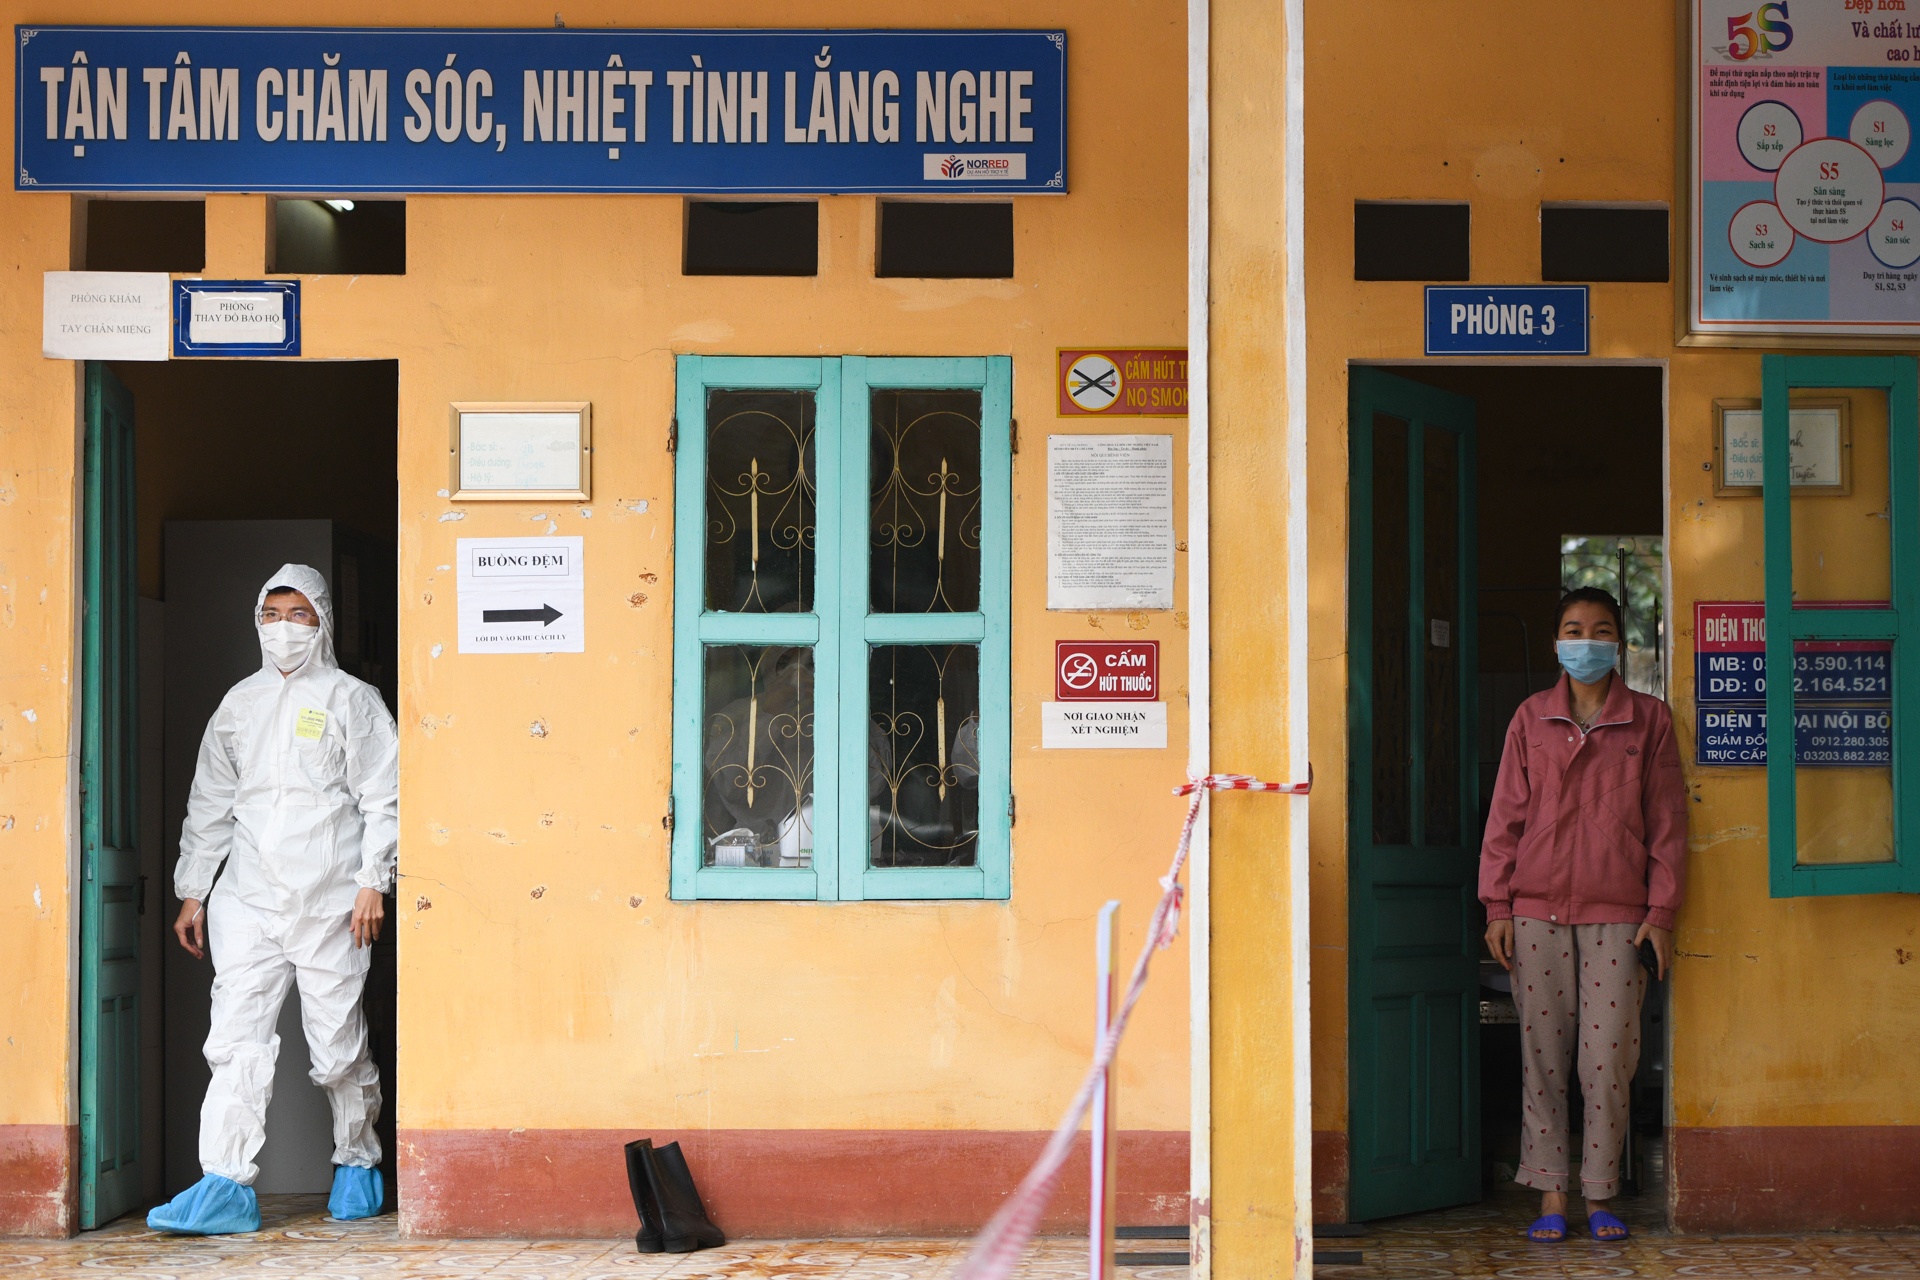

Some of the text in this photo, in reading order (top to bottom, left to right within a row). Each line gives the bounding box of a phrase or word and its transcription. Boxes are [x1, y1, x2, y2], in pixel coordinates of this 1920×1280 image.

[1727, 1, 1794, 60] 5S
[1851, 19, 1902, 38] Và chất
[1887, 49, 1910, 61] cao
[40, 45, 1034, 160] TẬN TÂM CHĂM SÓC, NHIỆT TÌNH LẮNG NGHE
[1763, 124, 1776, 137] S2
[1873, 121, 1886, 133] S1
[966, 159, 1009, 168] NORRED
[1820, 162, 1839, 180] S5
[1755, 224, 1768, 236] S3
[1891, 219, 1904, 232] S4
[1863, 271, 1875, 281] Duy
[1897, 282, 1906, 291] S3
[71, 292, 141, 304] PHÒNG KHÁM
[220, 300, 254, 311] PHÒNG
[195, 314, 222, 322] THAY
[265, 313, 280, 324] HỘ
[1451, 295, 1556, 335] PHÒNG 3
[61, 322, 151, 336] TAY CHÂN MIỆNG
[1125, 353, 1150, 380] CẤM
[1153, 355, 1175, 380] HÚT
[1126, 387, 1148, 407] NO
[478, 553, 563, 569] BUỒNG ĐỆM
[1705, 613, 1766, 647] ĐIỆN THO
[1105, 649, 1146, 667] CẤM
[1709, 657, 1746, 672] MB:
[1099, 671, 1152, 692] HÚT THUỐC
[1709, 678, 1747, 692] DĐ:
[1063, 711, 1146, 723] NƠI GIAO NHẬN
[1705, 710, 1751, 732] ĐIỆN
[1824, 711, 1858, 733] NỘI
[1864, 711, 1890, 733] BỘ
[1071, 723, 1138, 736] XÉT NGHIỆM
[1707, 733, 1741, 746] GIÁM
[1812, 737, 1889, 747] 0912.280.305
[1706, 750, 1739, 762] TRỰC
[1740, 747, 1767, 761] CẤP
[1803, 751, 1890, 761] 03203.882.282
